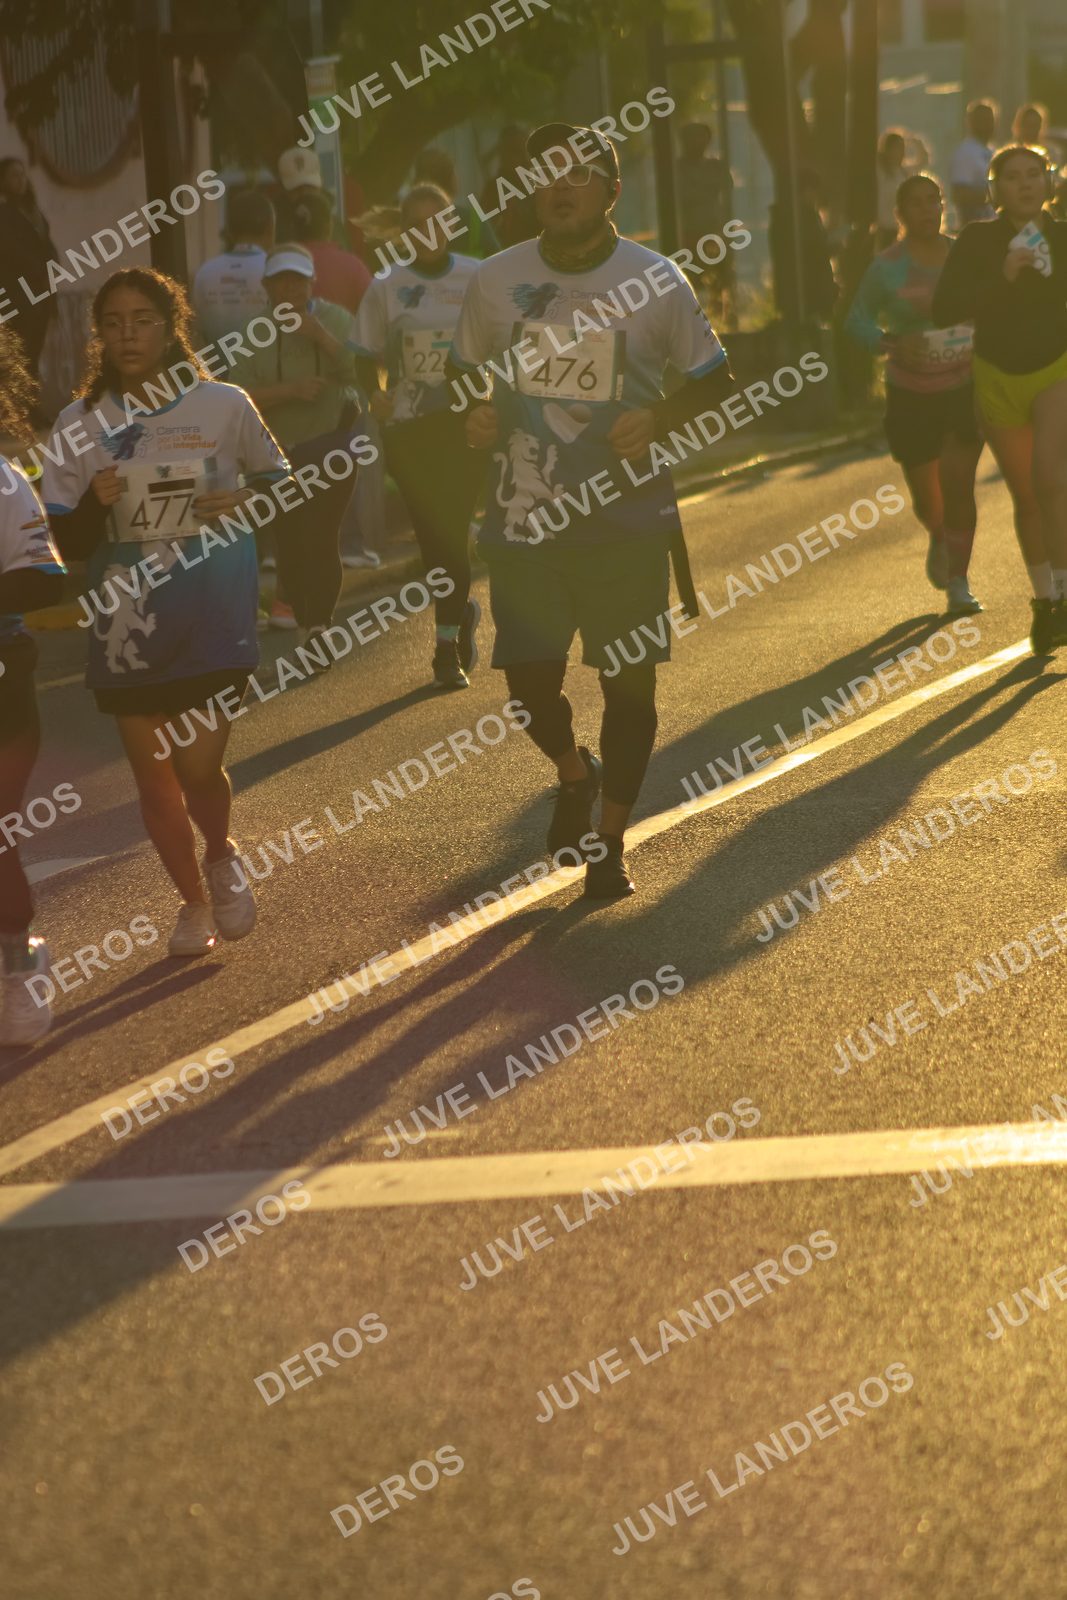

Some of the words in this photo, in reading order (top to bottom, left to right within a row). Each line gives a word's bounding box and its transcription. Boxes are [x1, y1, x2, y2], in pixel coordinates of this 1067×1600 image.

[531, 356, 597, 391] 476
[156, 426, 201, 435] Carrera
[130, 492, 194, 530] 477
